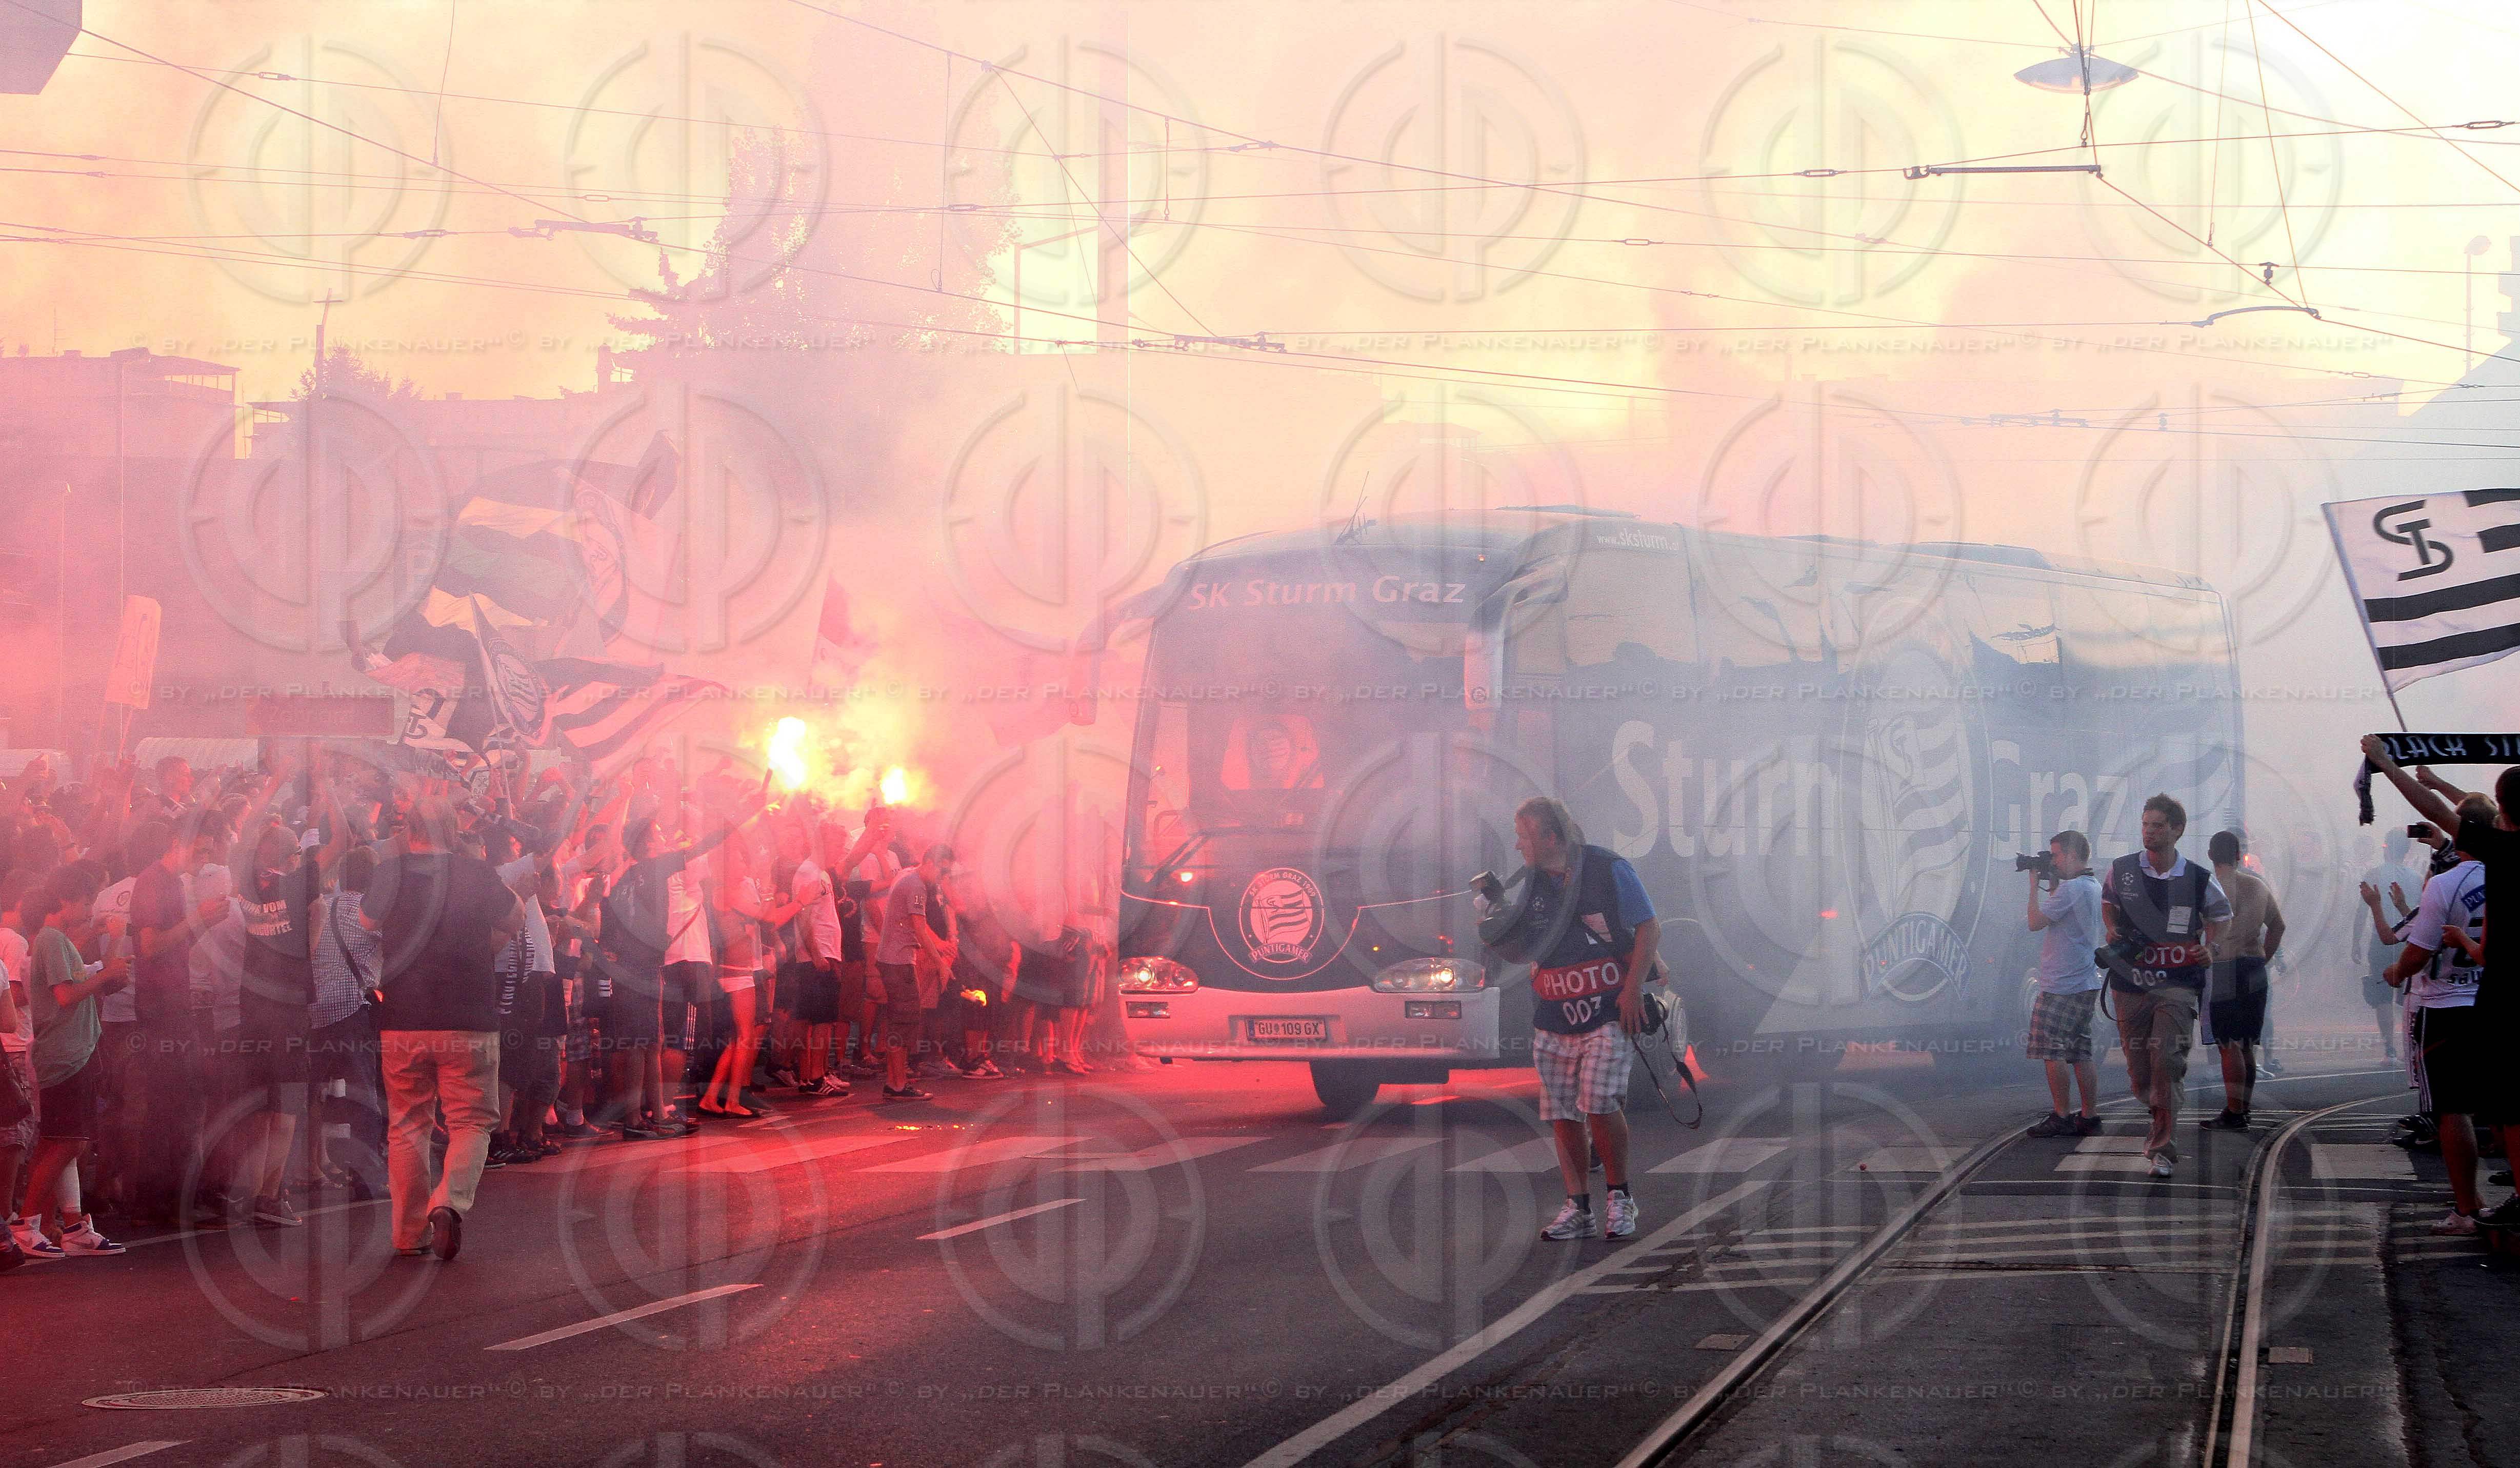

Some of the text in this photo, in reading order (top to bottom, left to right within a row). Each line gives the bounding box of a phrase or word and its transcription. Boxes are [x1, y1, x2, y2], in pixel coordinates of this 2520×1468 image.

[1189, 575, 1467, 610] SK Sturm Graz
[1612, 720, 1838, 860] Sturm
[1282, 872, 1302, 882] GRAZ
[1252, 944, 1309, 961] PUNTIGAMER
[2143, 945, 2186, 965] OTO
[1544, 962, 1619, 996] PHOTO
[1258, 1022, 1319, 1035] GU 109 GX
